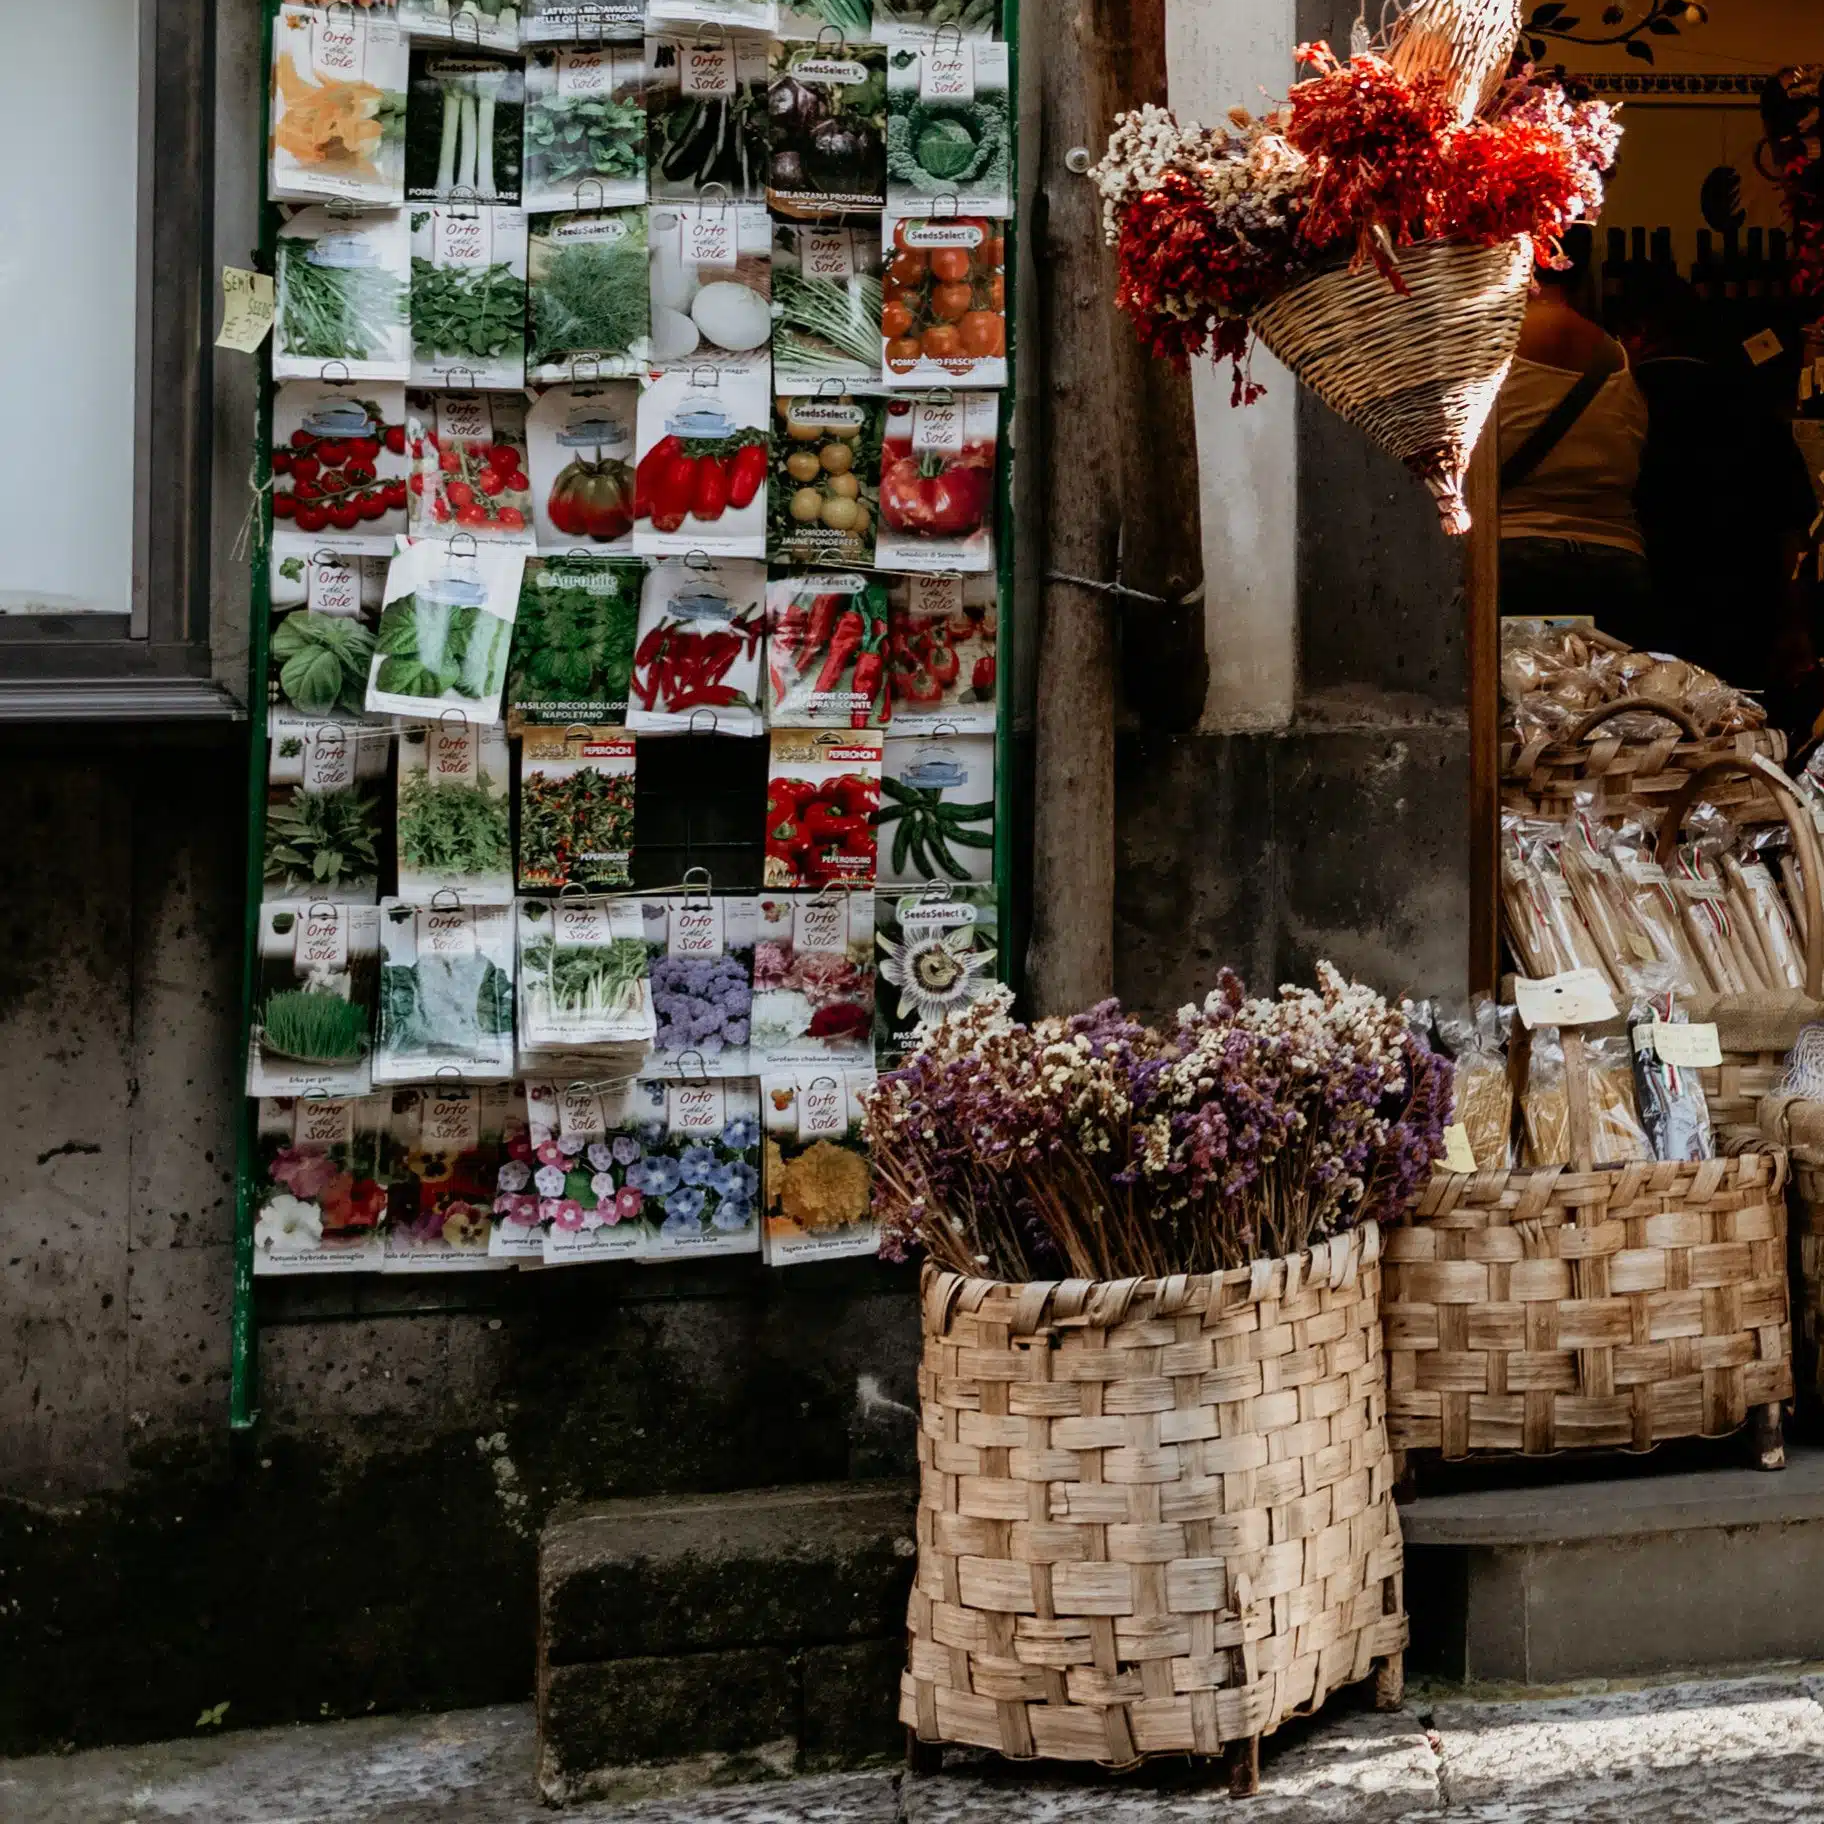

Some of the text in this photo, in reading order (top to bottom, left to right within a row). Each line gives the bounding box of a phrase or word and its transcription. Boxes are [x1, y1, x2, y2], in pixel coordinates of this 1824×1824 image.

[323, 32, 354, 44] Orto
[321, 56, 354, 68] Sole
[692, 56, 726, 67] Orto
[933, 61, 962, 72] Orto
[798, 64, 850, 74] SeedsSelect
[691, 78, 728, 89] Sole
[930, 81, 965, 93] Sole
[446, 225, 481, 235] Orto
[557, 226, 610, 236] SeedsSelect
[693, 226, 728, 236] Orto
[912, 231, 965, 240] SeedsSelect
[810, 240, 843, 250] Orto
[444, 246, 481, 258] Sole
[692, 247, 729, 258] Sole
[811, 261, 846, 272] Sole
[794, 409, 847, 418] SeedsSelect
[924, 410, 955, 421] Orto
[921, 431, 956, 444] Sole
[320, 572, 351, 584] Orto
[318, 595, 352, 607] Sole
[515, 702, 558, 710] BASILICO
[560, 702, 587, 710] RICCIO
[543, 711, 603, 719] NAPOLETANO
[439, 738, 469, 749] Orto
[315, 748, 346, 759] Orto
[437, 761, 471, 773] Sole
[313, 771, 347, 783] Sole
[805, 912, 836, 923] Orto
[905, 910, 959, 919] SeedsSelect
[680, 916, 713, 927] Orto
[307, 925, 337, 936] Orto
[678, 939, 714, 950] Sole
[803, 933, 840, 945] Sole
[305, 948, 339, 960] Sole
[565, 1097, 592, 1107] Orto
[680, 1093, 715, 1103] Orto
[808, 1095, 838, 1106] Orto
[308, 1104, 344, 1115] Orto
[434, 1104, 469, 1114] Orto
[569, 1118, 598, 1130] Sole
[680, 1115, 715, 1126] Sole
[809, 1118, 840, 1129] Sole
[306, 1126, 344, 1139] Sole
[431, 1126, 470, 1138] Sole
